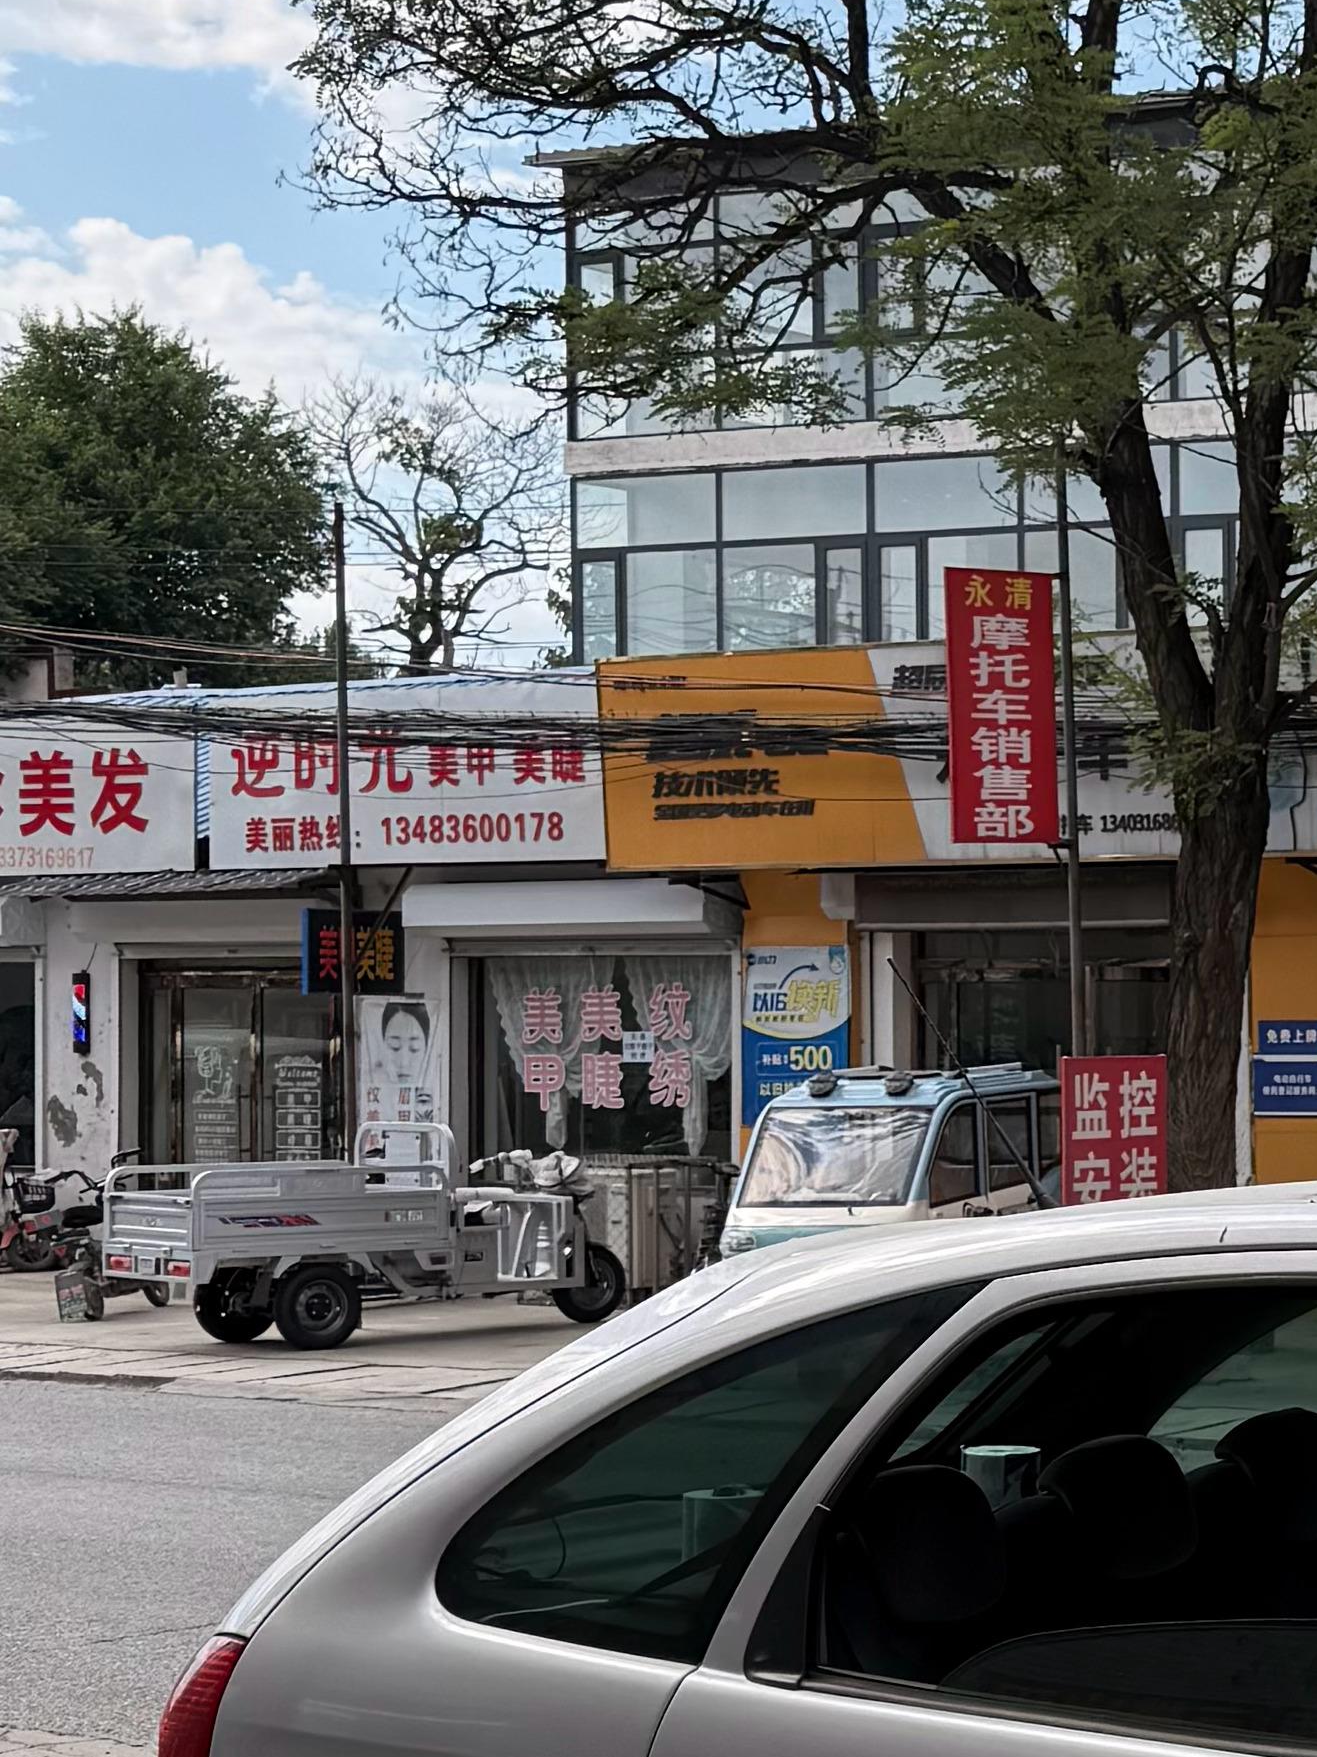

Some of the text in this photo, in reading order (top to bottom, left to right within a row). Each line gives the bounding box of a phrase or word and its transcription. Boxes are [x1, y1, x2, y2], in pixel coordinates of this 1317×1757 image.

[965, 575, 1033, 610] 永清
[969, 614, 1034, 840] 摩托车销售部
[0, 747, 149, 837] 美发
[381, 812, 564, 846] 13483600178
[319, 925, 394, 981] 美美睫
[789, 1045, 832, 1072] 500
[1072, 1070, 1158, 1141] 监控
